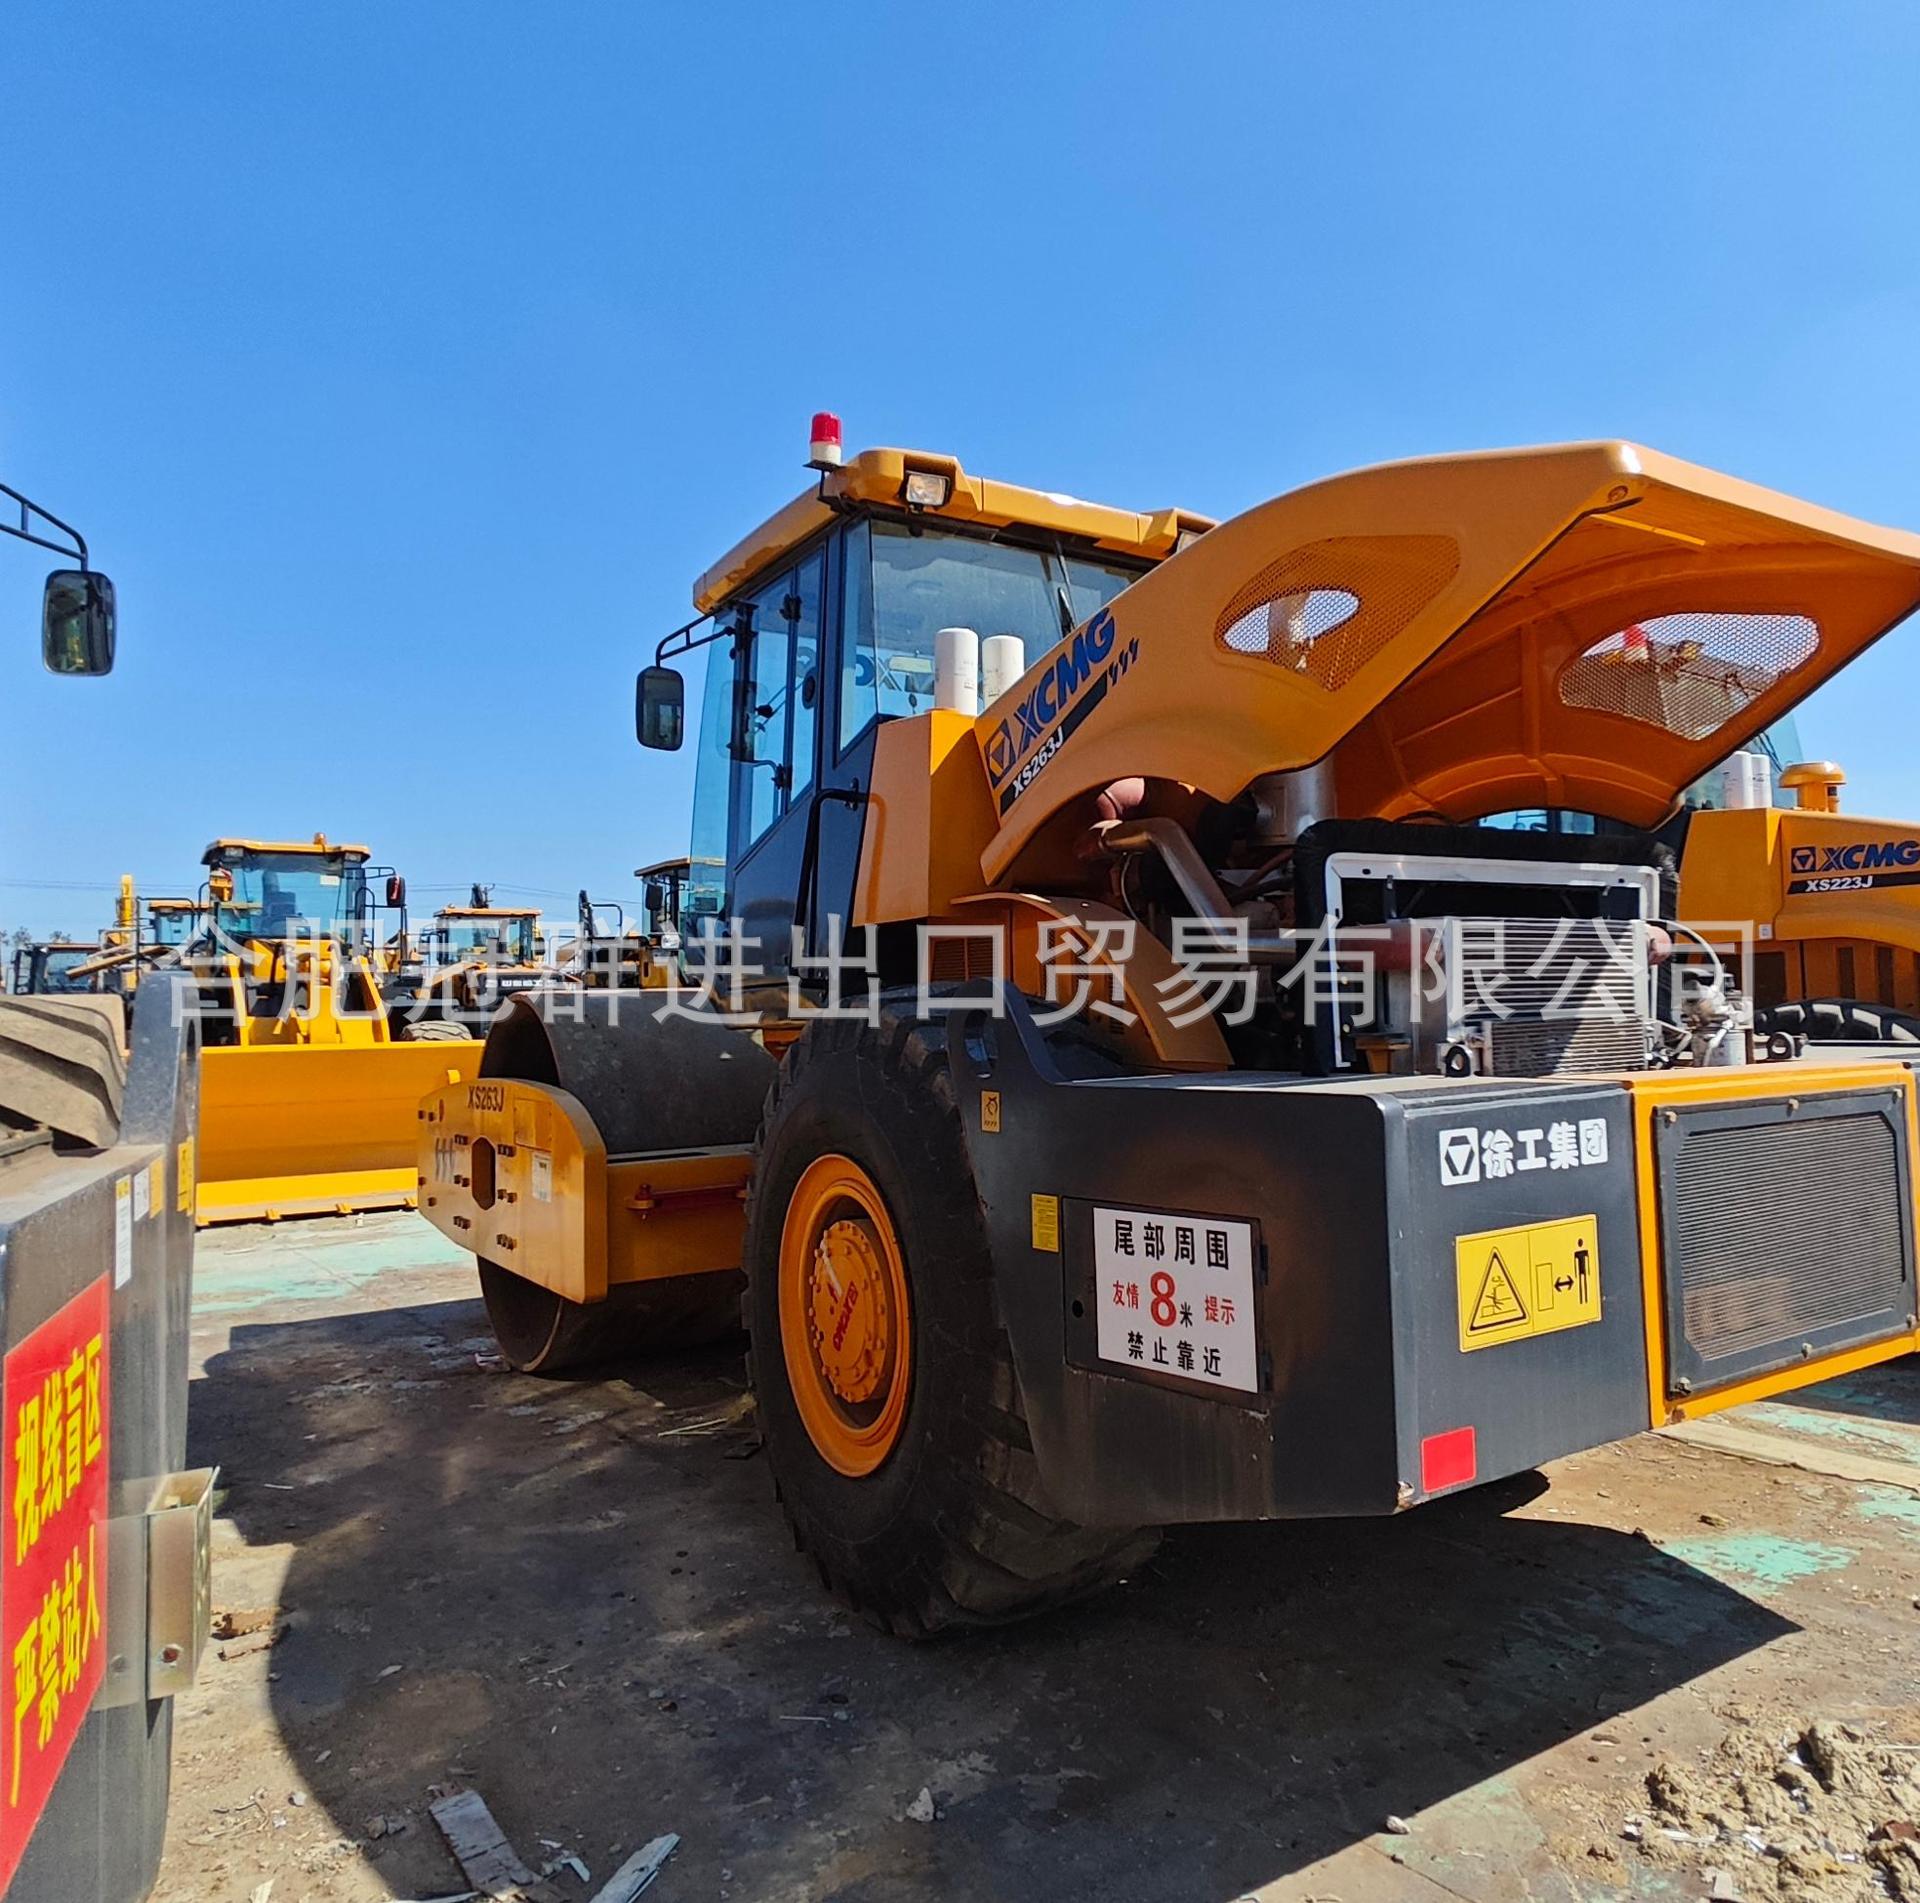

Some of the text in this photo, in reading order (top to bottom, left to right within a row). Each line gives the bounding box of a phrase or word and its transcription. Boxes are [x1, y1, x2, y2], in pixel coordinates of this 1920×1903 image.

[1014, 607, 1115, 758] XCMG
[1012, 725, 1064, 799] XS263J
[1819, 840, 1920, 872] XCMG
[1804, 875, 1873, 892] XS223J
[467, 1085, 505, 1112] XS263J
[1481, 1118, 1609, 1179] 徐工集团
[1114, 1219, 1229, 1270] 尾部周围
[1112, 1280, 1139, 1310] 友情
[1205, 1294, 1236, 1325] 提示
[1128, 1330, 1222, 1377] 禁止靠近
[14, 1333, 102, 1567] 视线盲区
[10, 1524, 100, 1808] 严禁站人
